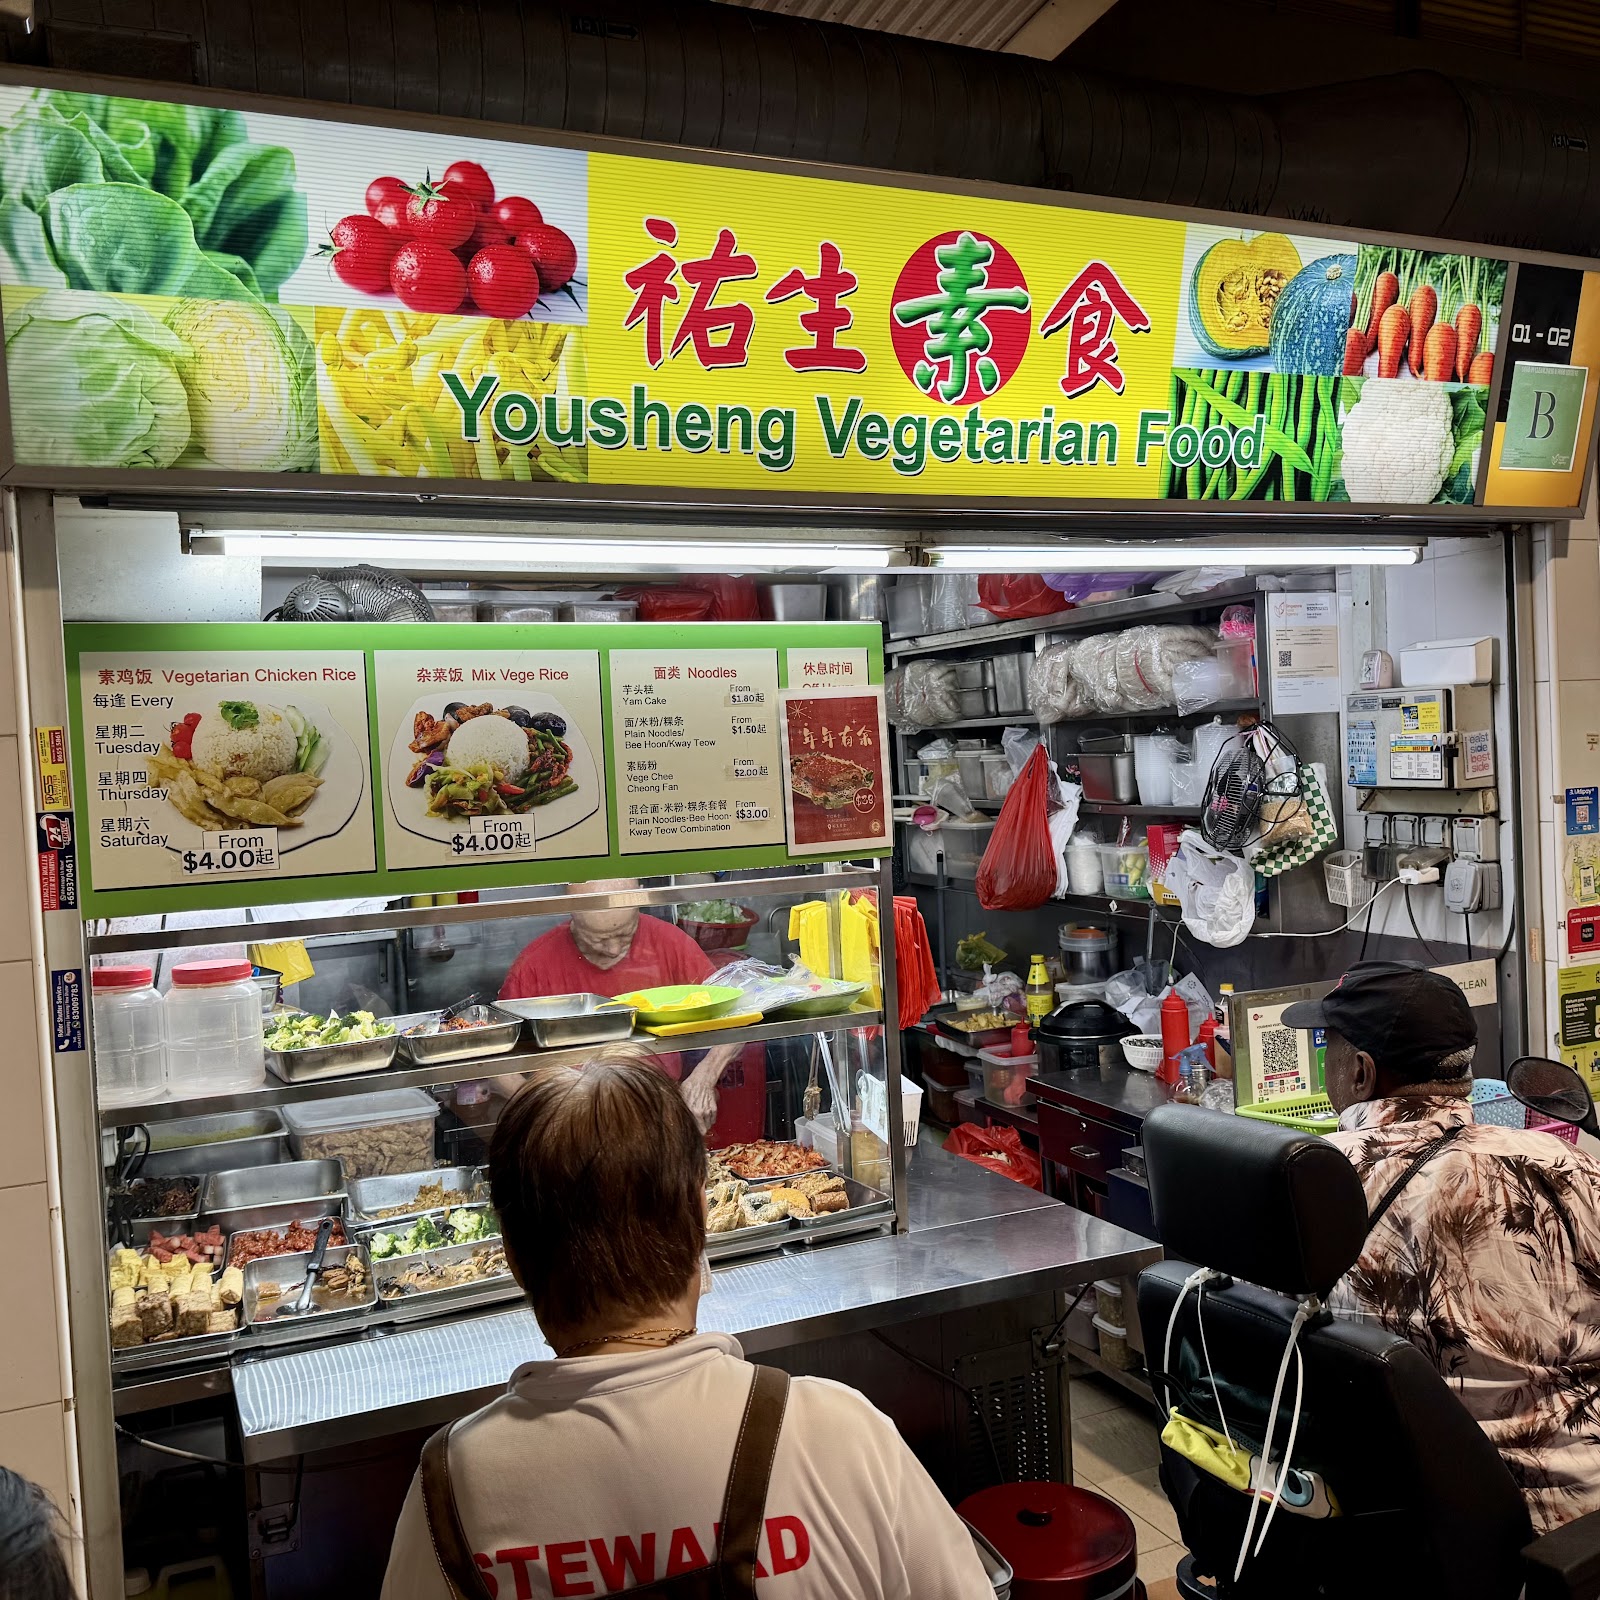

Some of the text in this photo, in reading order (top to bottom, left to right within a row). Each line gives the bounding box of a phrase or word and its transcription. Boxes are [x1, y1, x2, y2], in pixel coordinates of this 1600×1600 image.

[624, 215, 1152, 405] 祐生素食
[1526, 390, 1556, 439] B
[439, 371, 1266, 476] Yousheng Vegetarian Food
[416, 667, 569, 683] 杂菜饭 Mix Vege Rice
[653, 665, 737, 679] 面类 Noodles
[803, 661, 853, 676] 休息时间
[98, 667, 356, 685] 素鸡饭 Vegetarian Chicken Rice
[622, 684, 654, 695] 芋头糕
[729, 684, 750, 692] From
[93, 693, 174, 709] 每逢 Every
[623, 696, 667, 706] Yam Cake
[731, 715, 752, 724] From
[95, 724, 145, 739] 星期二
[624, 730, 646, 739] Plain
[1470, 732, 1489, 743] east
[95, 741, 161, 755] Tuesday
[625, 738, 716, 749] Bee Hoon/Kway Teow
[1470, 743, 1488, 753] side
[733, 758, 754, 766] From
[1471, 752, 1491, 763] best
[626, 760, 657, 771] 素肠粉
[1472, 762, 1490, 772] side
[98, 771, 148, 785] 星期四
[627, 772, 674, 783] Vege Chee
[97, 787, 169, 801] Thursday
[627, 783, 679, 794] Cheong Fan
[735, 800, 757, 808] From
[100, 817, 150, 832] 星期六
[483, 819, 522, 833] From
[629, 817, 650, 826] Plain
[49, 826, 62, 843] 24
[60, 820, 70, 845] SERVICE
[629, 823, 731, 837] Kway Teow Combination
[100, 833, 169, 848] Saturday
[218, 834, 264, 849] From
[452, 832, 532, 855] $4.00起
[183, 848, 274, 873] $4.00起
[41, 854, 50, 909] EMERGENCY ROLLER
[48, 853, 57, 909] SHUTTER REPAIRING
[65, 855, 75, 906] +6593704611
[55, 986, 63, 1004] Service
[71, 983, 80, 1020] 83009783
[472, 1514, 811, 1600] STEWAD
